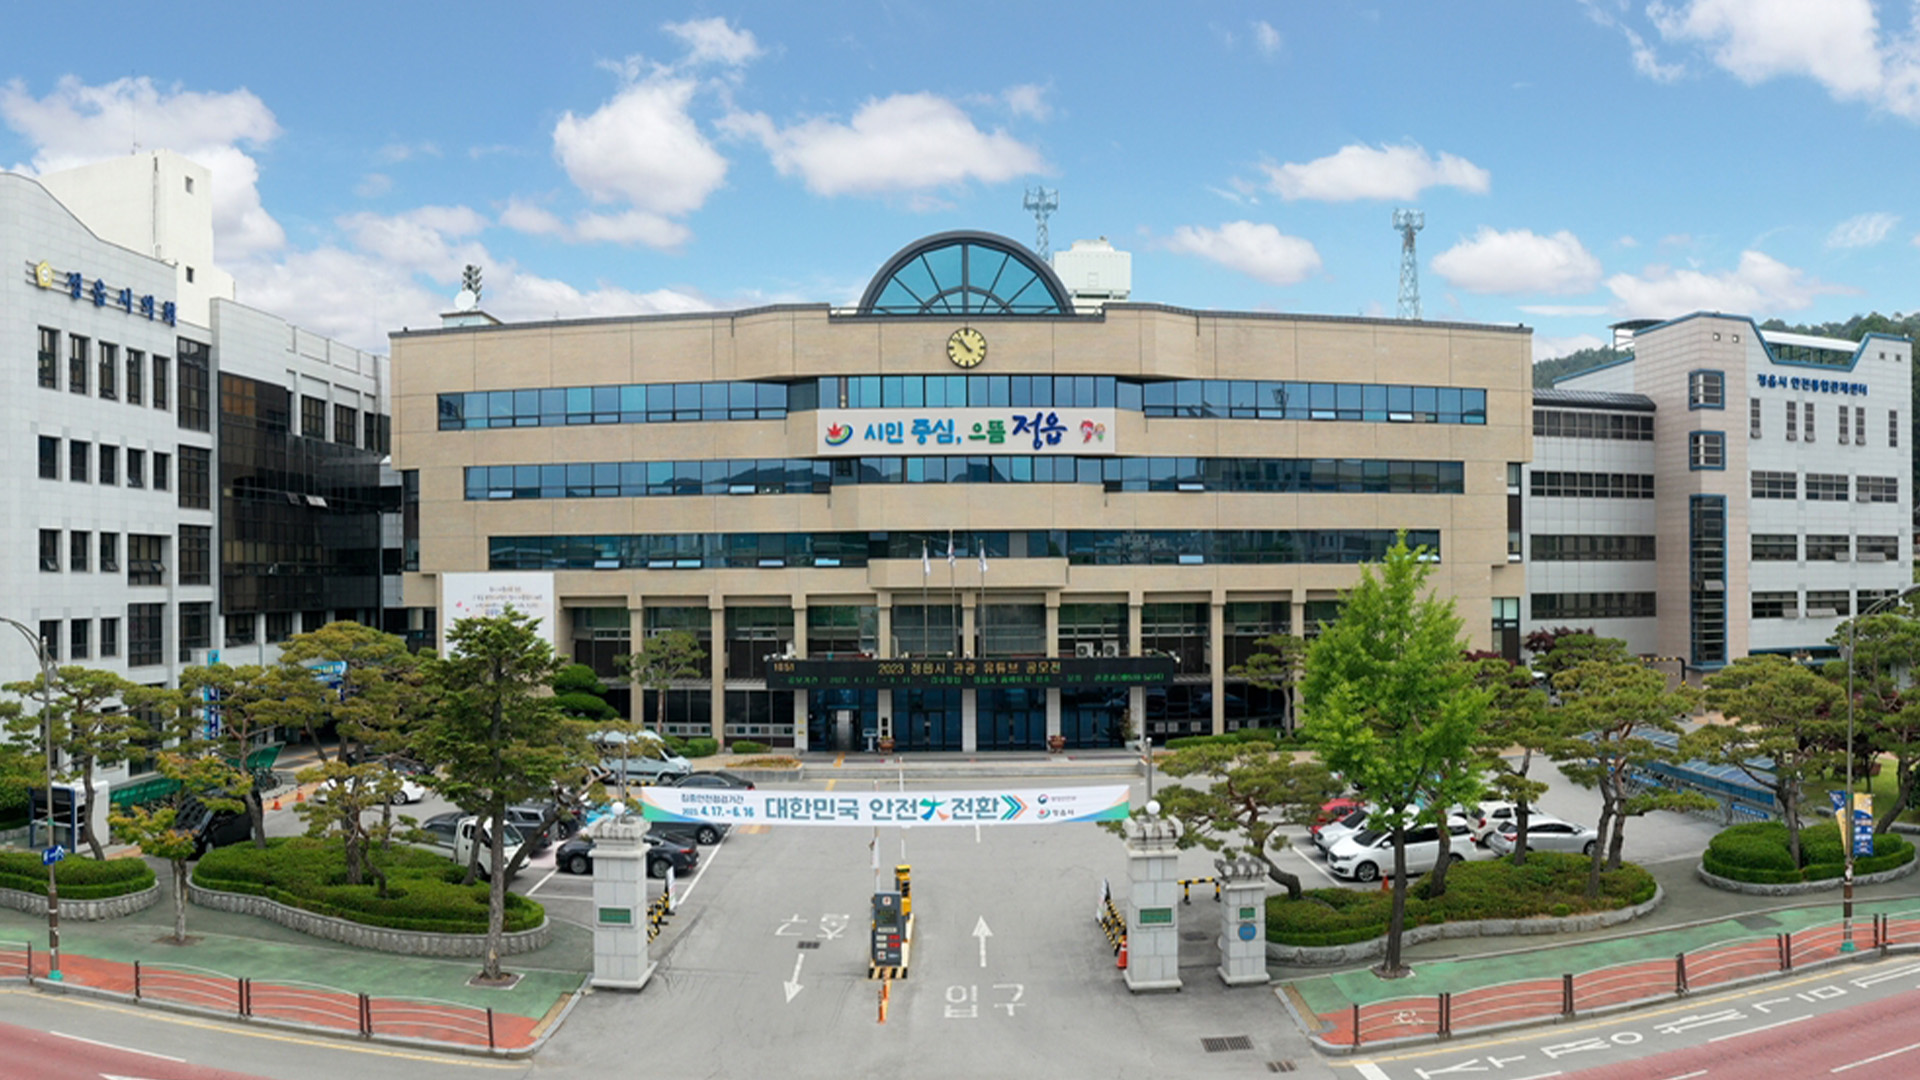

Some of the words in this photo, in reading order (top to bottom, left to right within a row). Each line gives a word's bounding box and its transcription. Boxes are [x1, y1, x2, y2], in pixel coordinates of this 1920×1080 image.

[66, 272, 175, 325] 정읍시의회
[1757, 374, 1788, 389] 정읍시
[1791, 377, 1868, 395] 안전통합관제센터
[864, 421, 904, 444] 시민
[911, 418, 962, 445] 중심,
[968, 420, 1006, 444] 으뜸
[1012, 411, 1068, 450] 정읍
[878, 662, 905, 675] 2023
[911, 662, 945, 675] 정읍시
[953, 662, 976, 675] 관광
[983, 661, 1020, 675] 유튜브
[1027, 661, 1061, 674] 공모전
[765, 796, 859, 821] 대한민국
[944, 984, 1026, 1018] 입구
